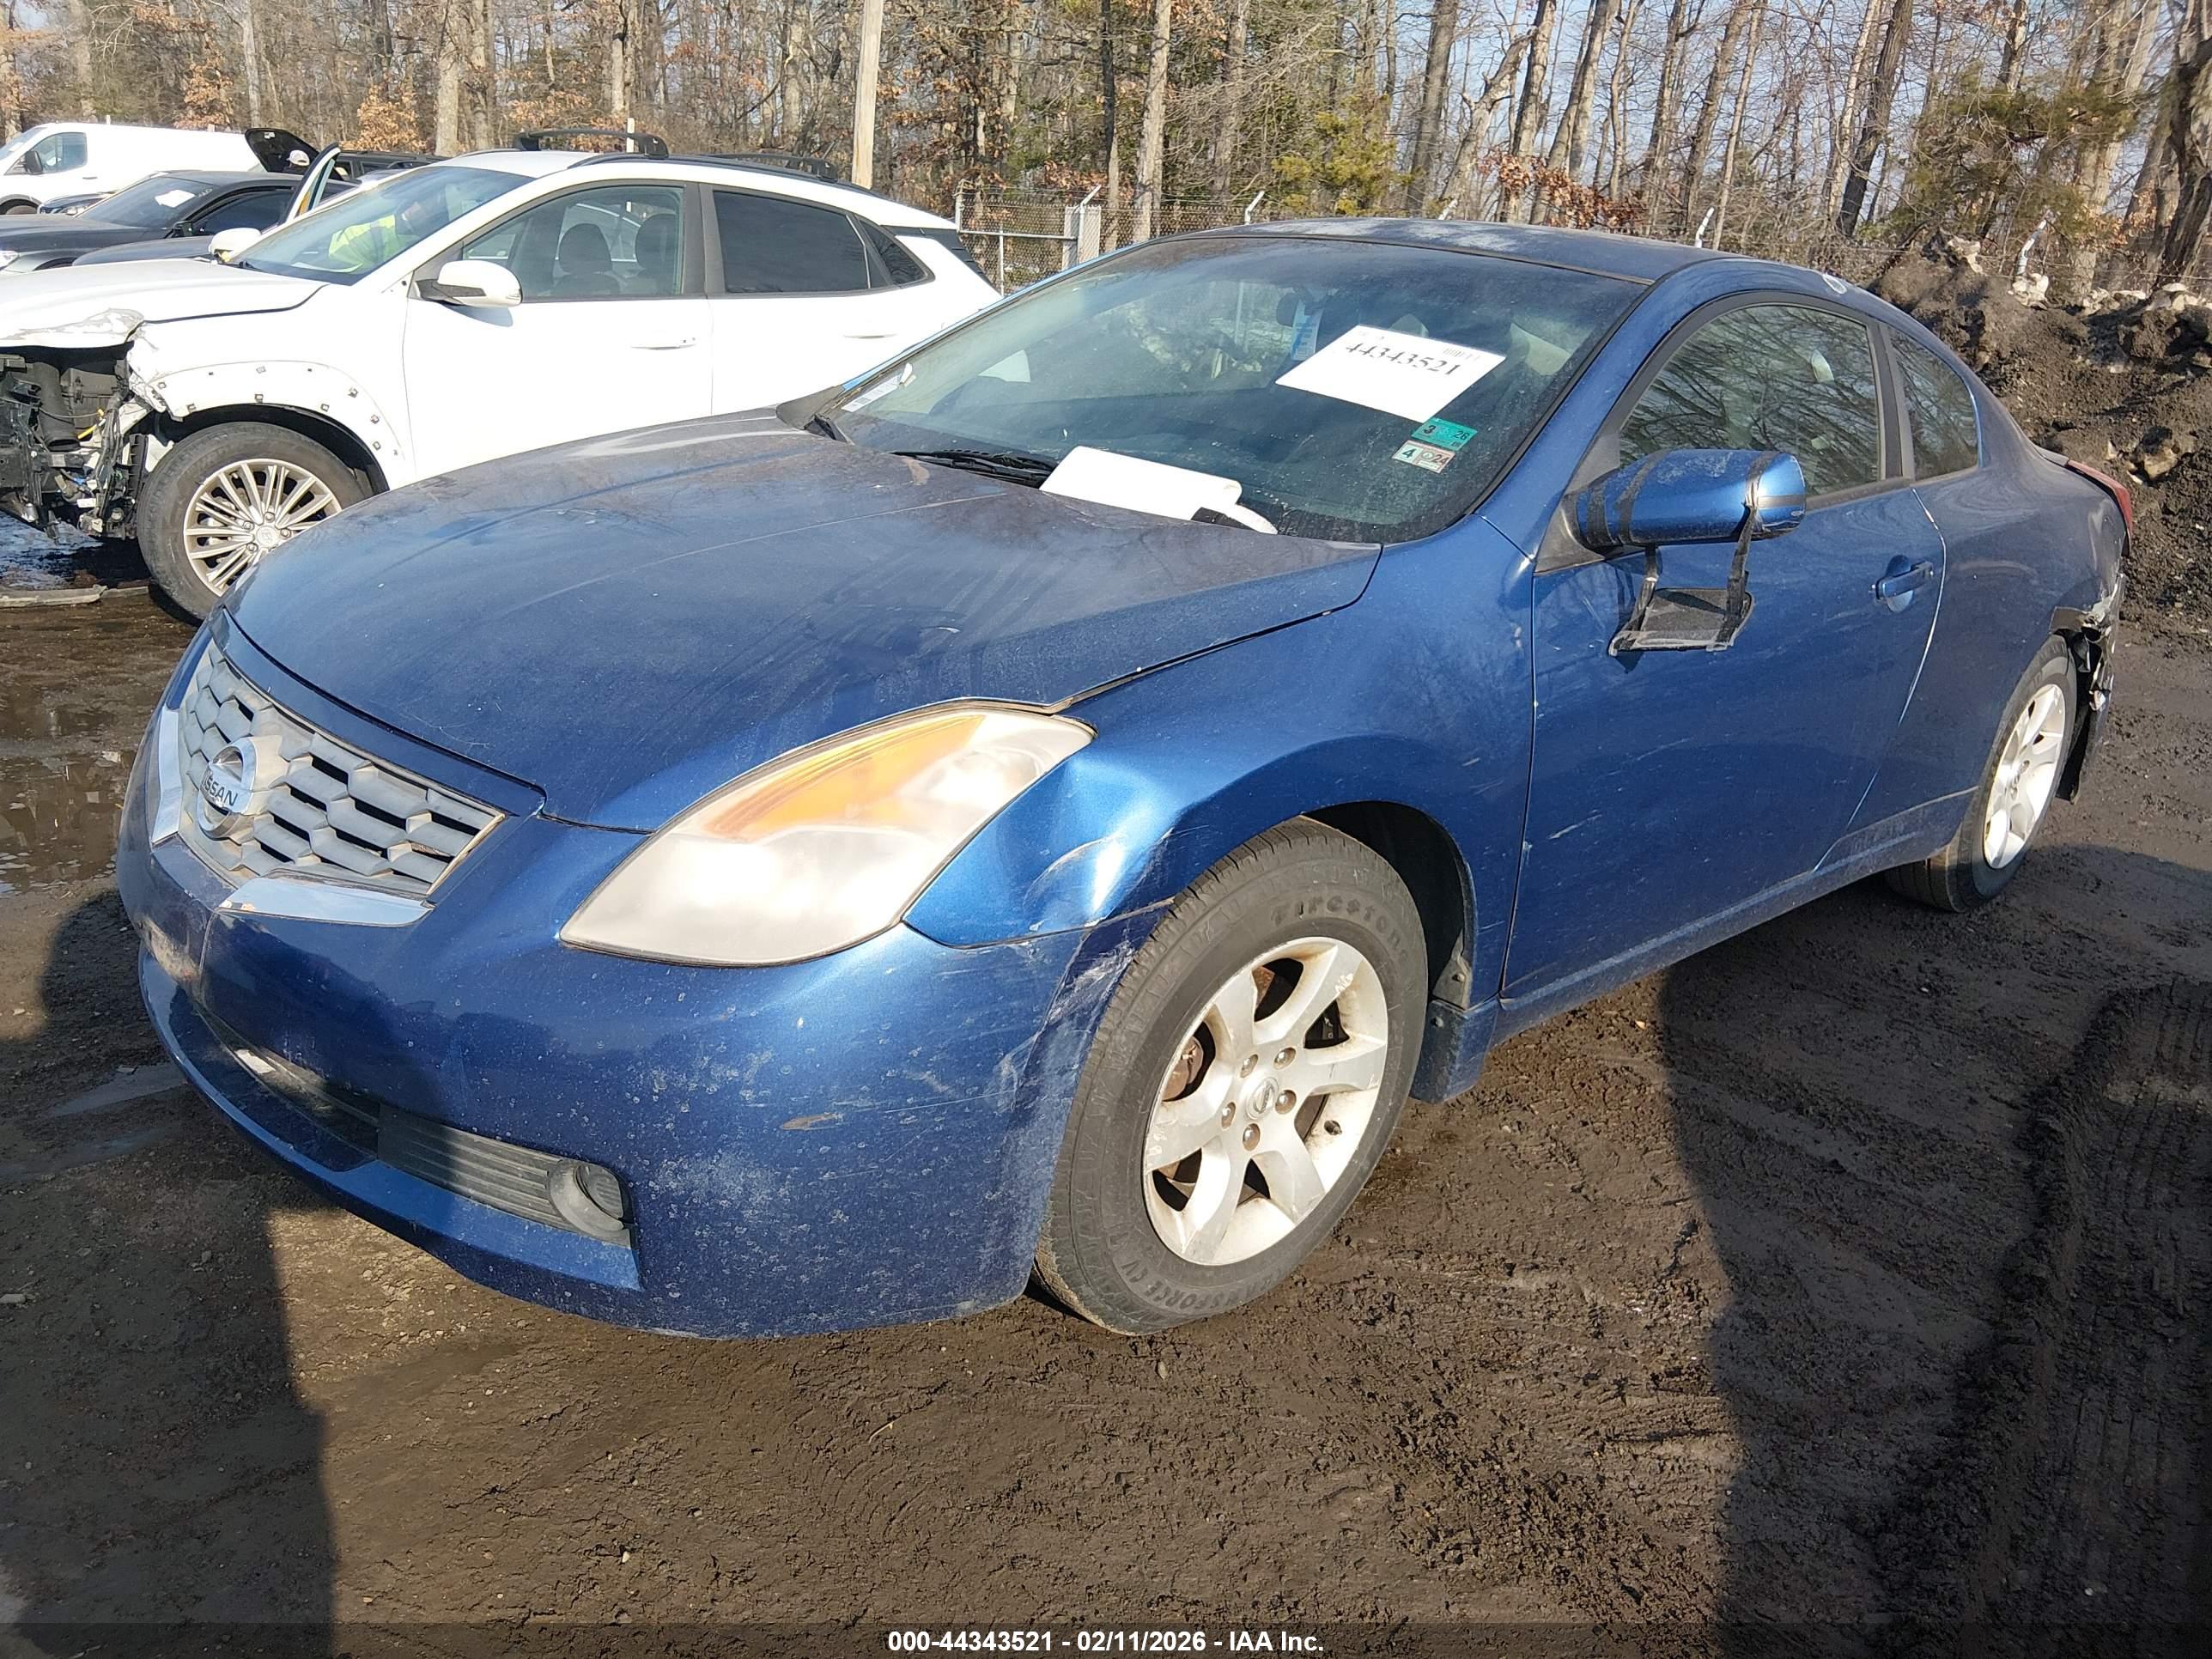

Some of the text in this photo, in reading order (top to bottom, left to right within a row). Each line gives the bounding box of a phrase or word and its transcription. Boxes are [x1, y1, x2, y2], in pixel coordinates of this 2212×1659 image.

[1346, 343, 1461, 375] 44343521
[1423, 424, 1437, 434] 3
[1401, 448, 1417, 459] 4
[1431, 453, 1450, 465] 24
